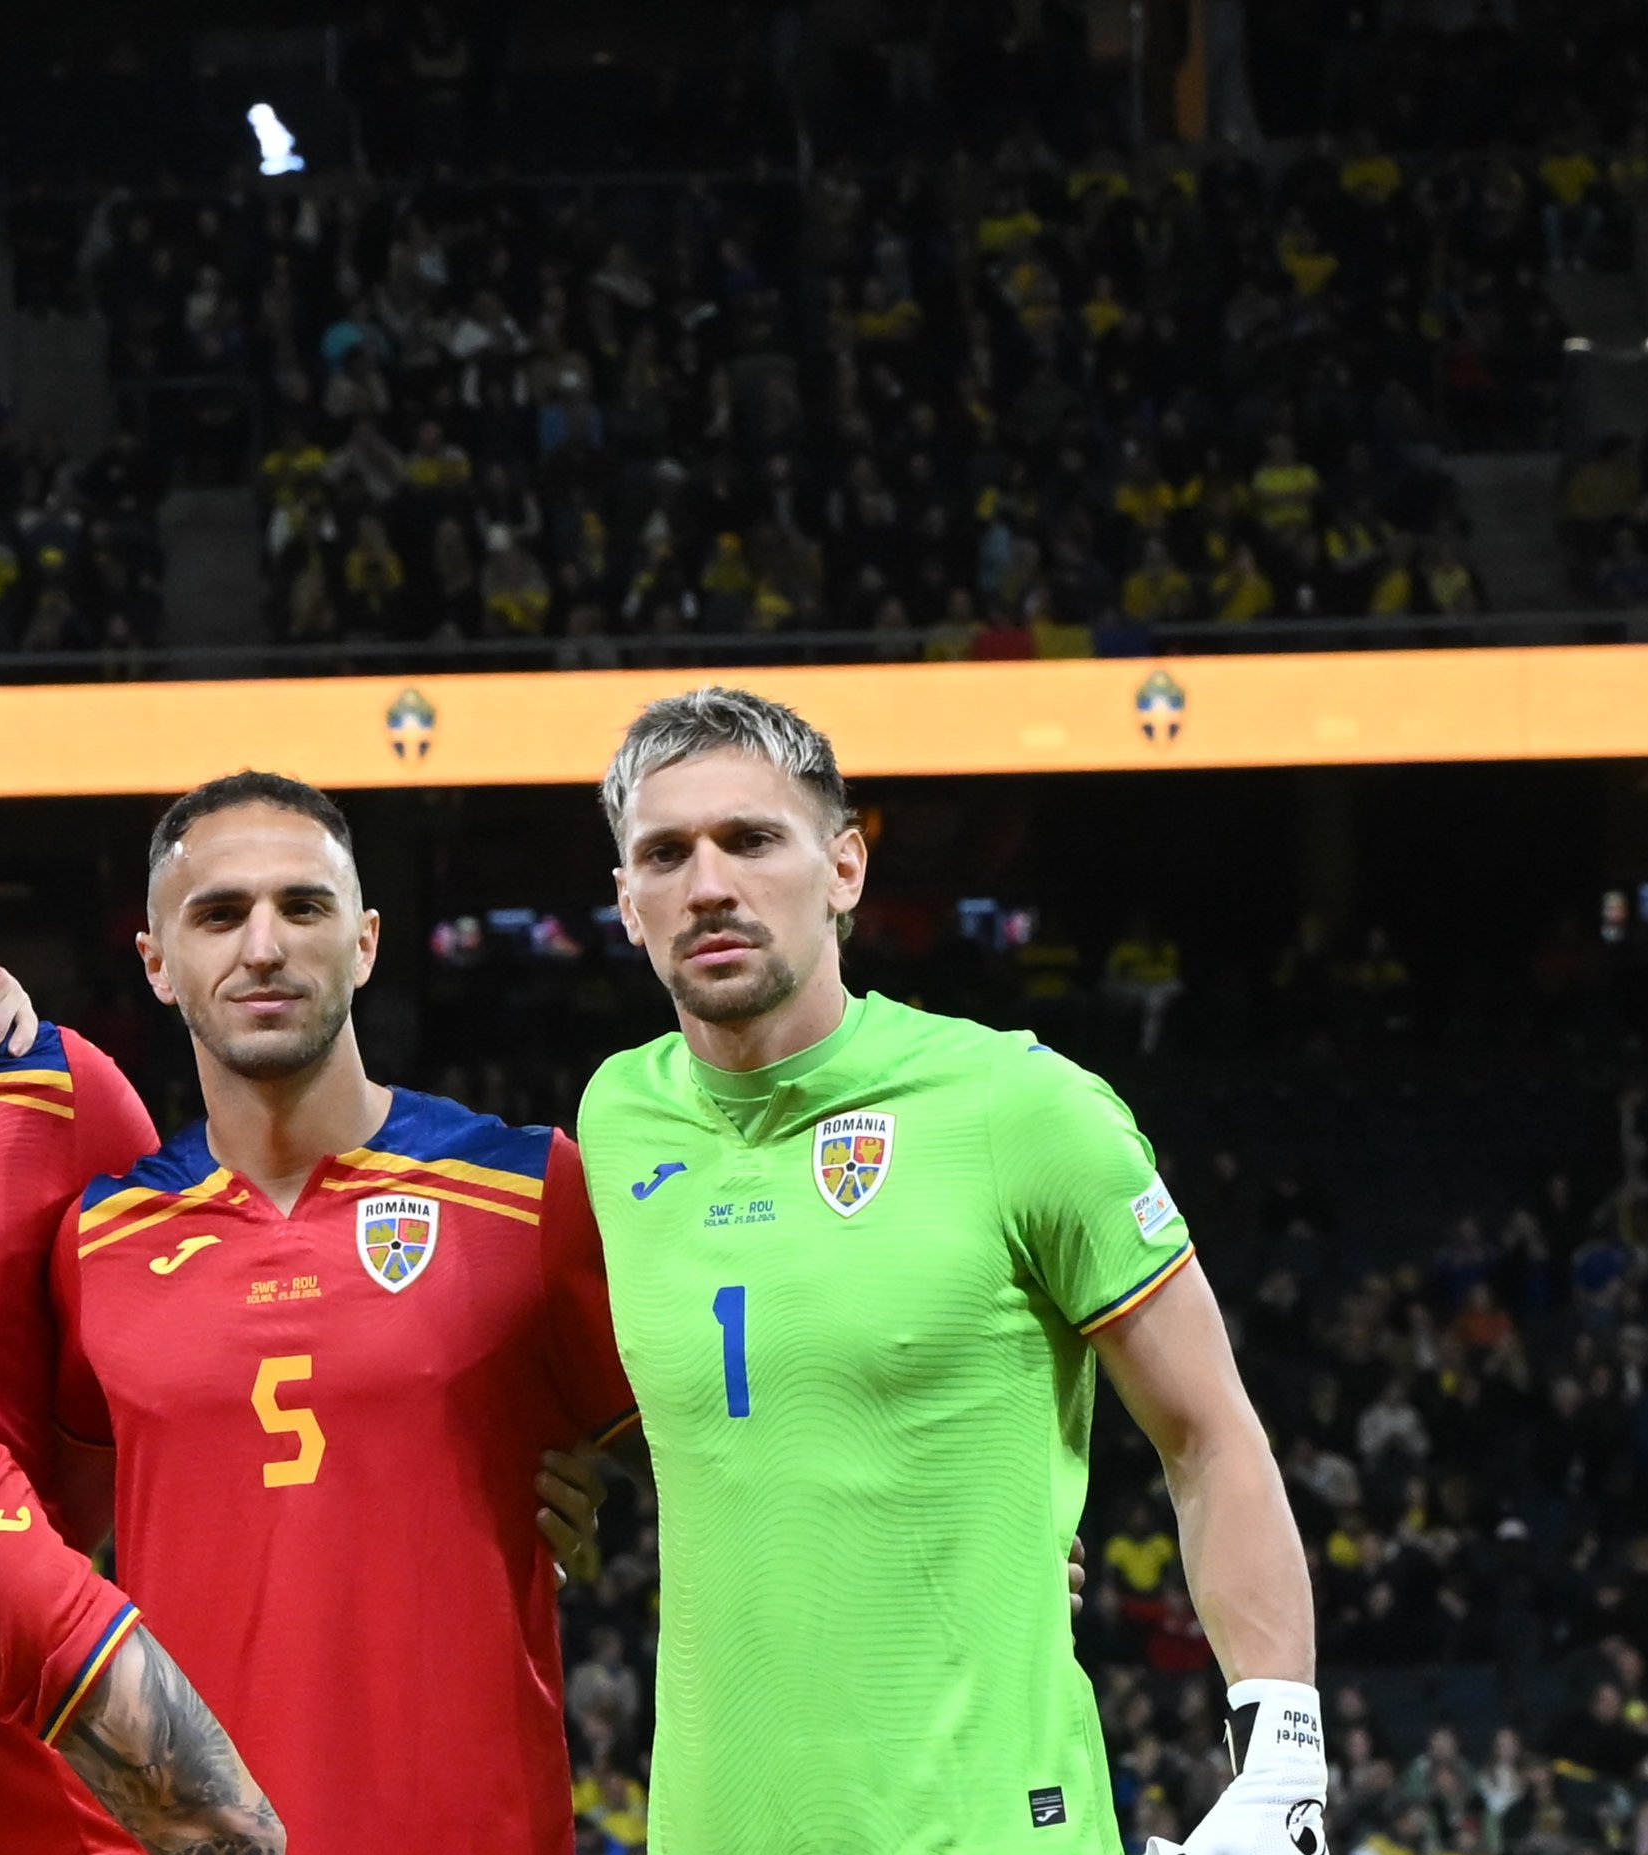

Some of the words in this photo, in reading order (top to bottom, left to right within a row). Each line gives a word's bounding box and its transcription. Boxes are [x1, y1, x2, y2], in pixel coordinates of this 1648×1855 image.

[823, 1115, 886, 1136] ROMÂNIA
[366, 1198, 430, 1217] ROMÂNIA
[709, 1204, 734, 1217] SWE
[750, 1200, 774, 1213] ROU
[252, 1281, 278, 1294] SWE
[292, 1276, 317, 1289] ROU
[712, 1285, 750, 1418] 1
[250, 1354, 326, 1488] 5
[1284, 1710, 1318, 1732] Radu
[1276, 1729, 1320, 1752] Andrei
